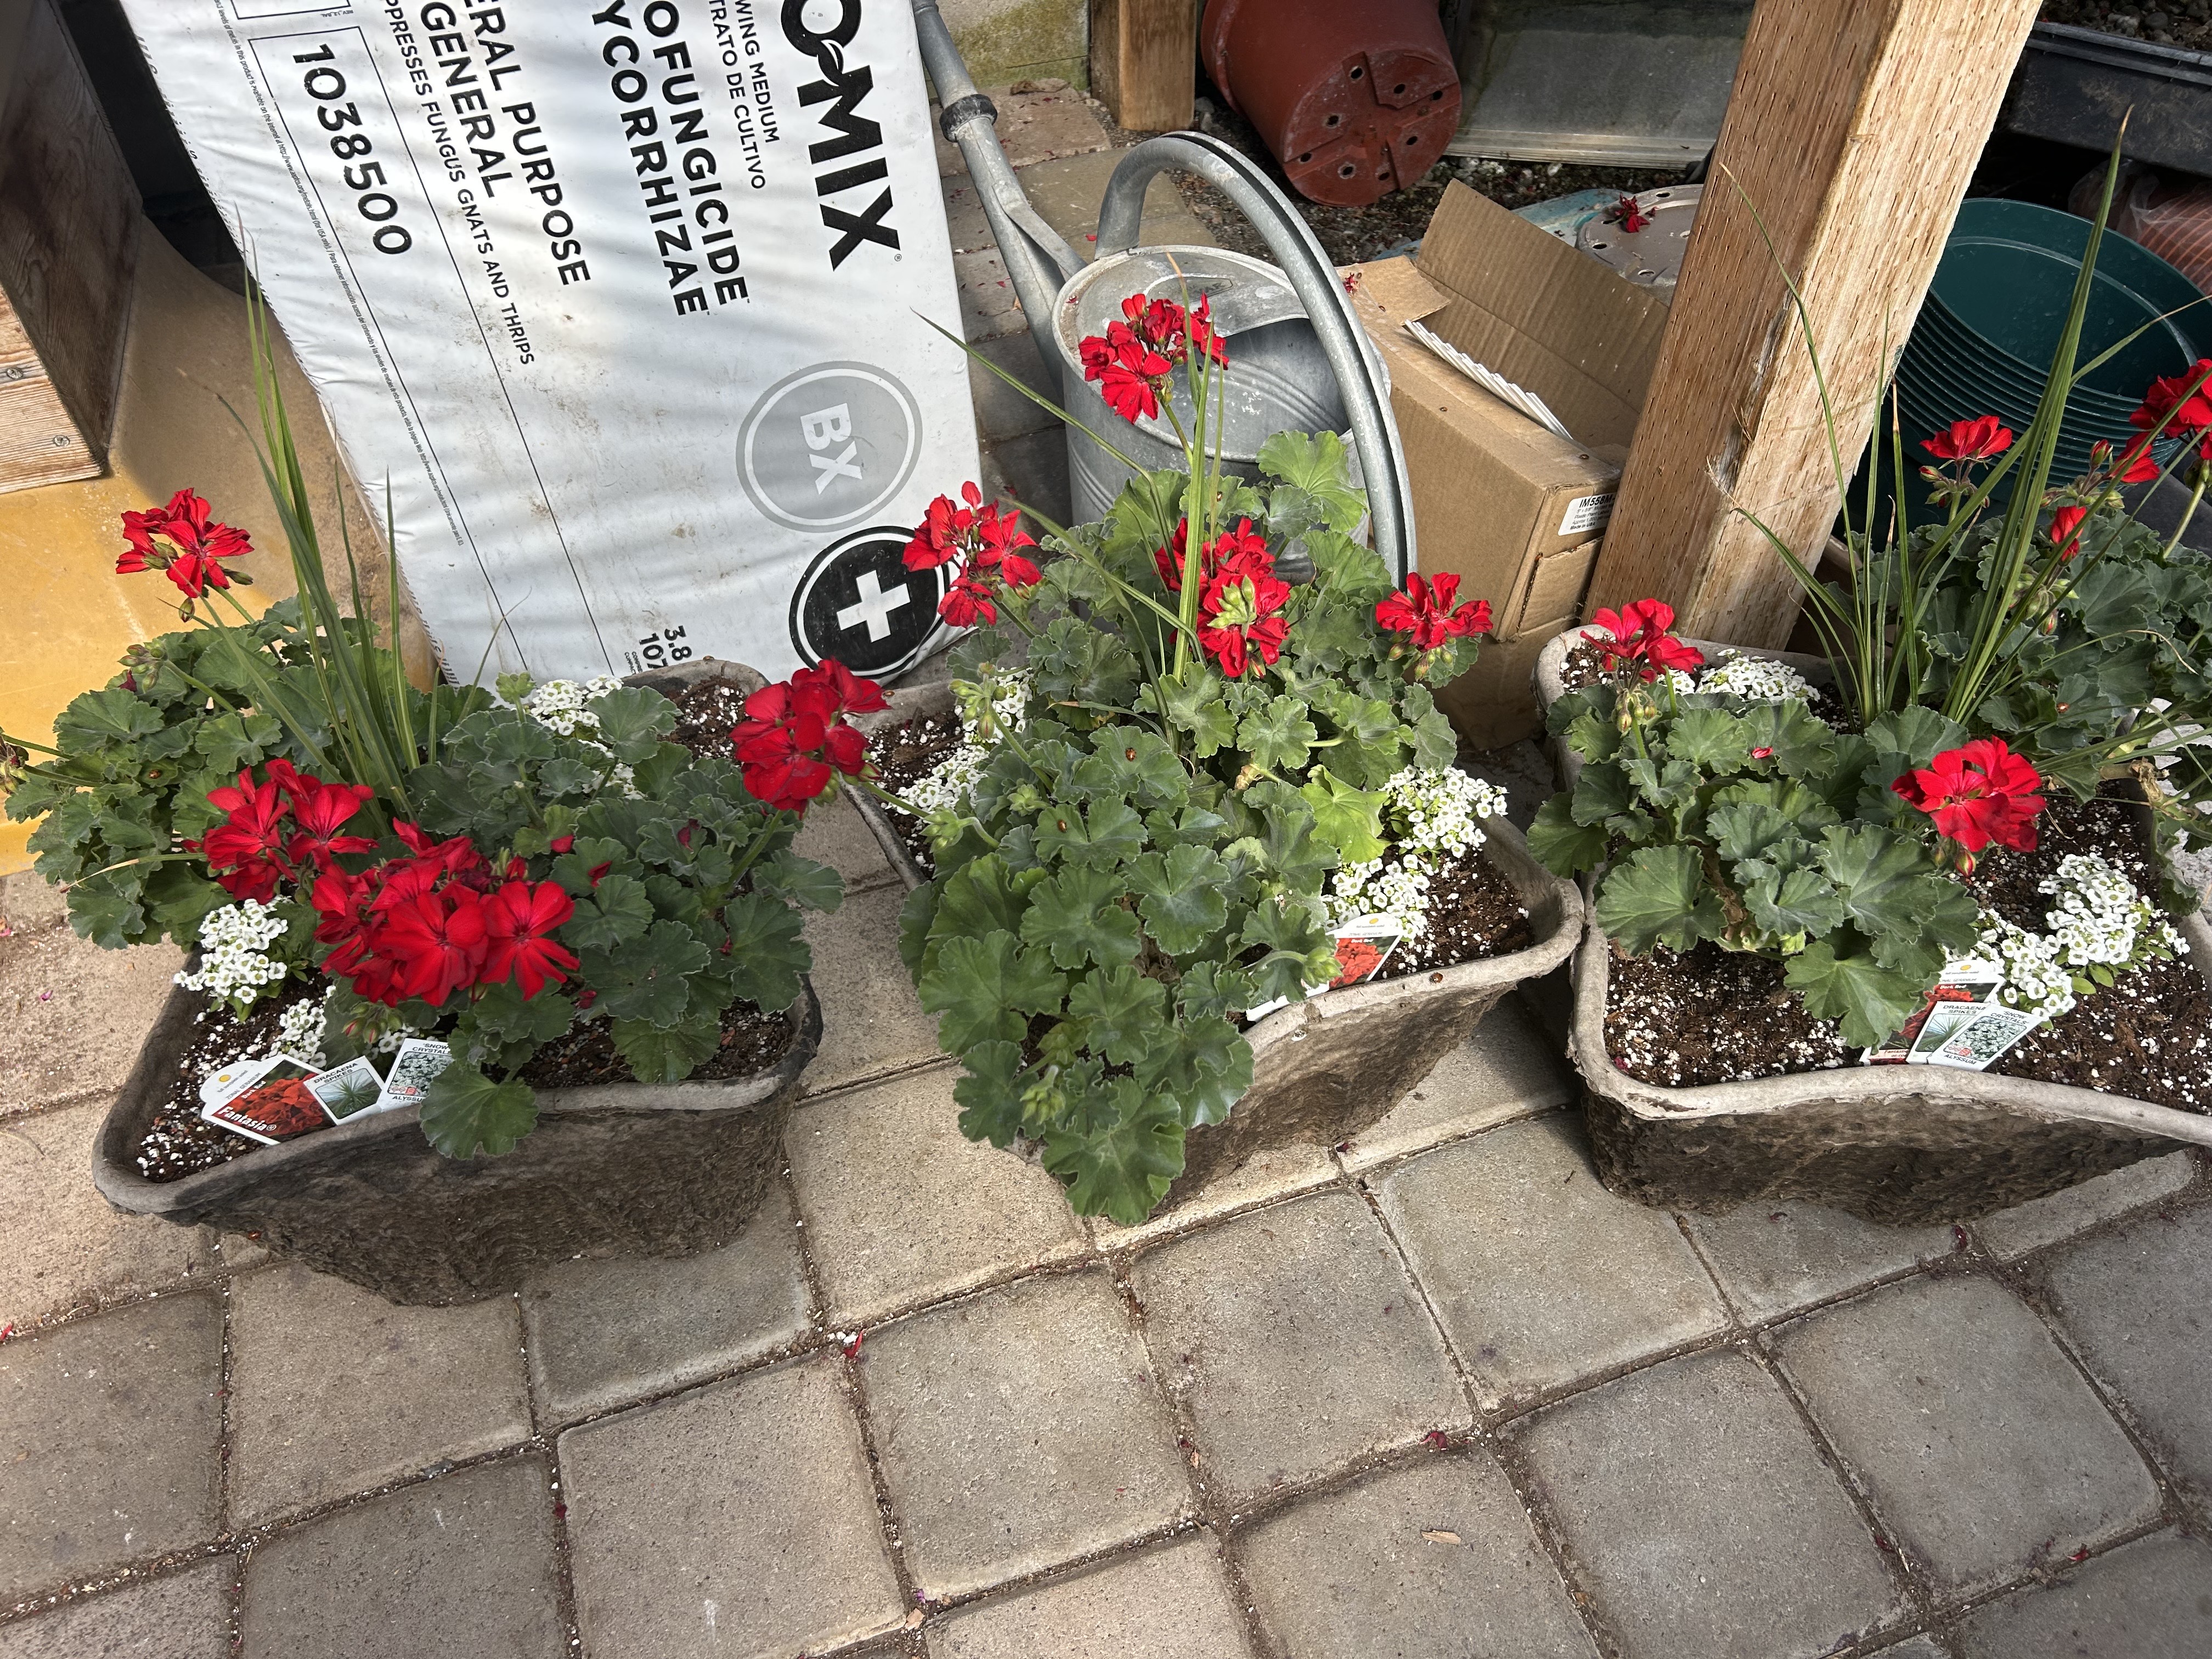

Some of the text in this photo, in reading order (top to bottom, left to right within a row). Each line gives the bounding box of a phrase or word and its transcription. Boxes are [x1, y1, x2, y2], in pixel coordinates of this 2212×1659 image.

[236, 50, 245, 60] this
[240, 61, 254, 79] product
[251, 86, 265, 106] available
[725, 71, 746, 100] DE
[420, 2, 514, 199] GENERAL
[748, 61, 780, 144] MEDIUM
[293, 43, 413, 255] 1038500
[733, 104, 766, 190] CULTIVO
[501, 101, 591, 286] PURPOSE
[317, 229, 326, 238] USA
[421, 101, 466, 183] FUNGUS
[458, 189, 494, 255] GNATS
[483, 259, 511, 299] AND
[500, 302, 535, 365] THRIPS
[329, 253, 337, 263] Para
[362, 324, 374, 344] contenido
[800, 402, 864, 495] BX
[664, 625, 692, 661] 3.8
[1944, 1054, 1977, 1065] ALYSSUM
[313, 1062, 359, 1084] DRACAENA
[324, 1069, 354, 1083] SPIKES
